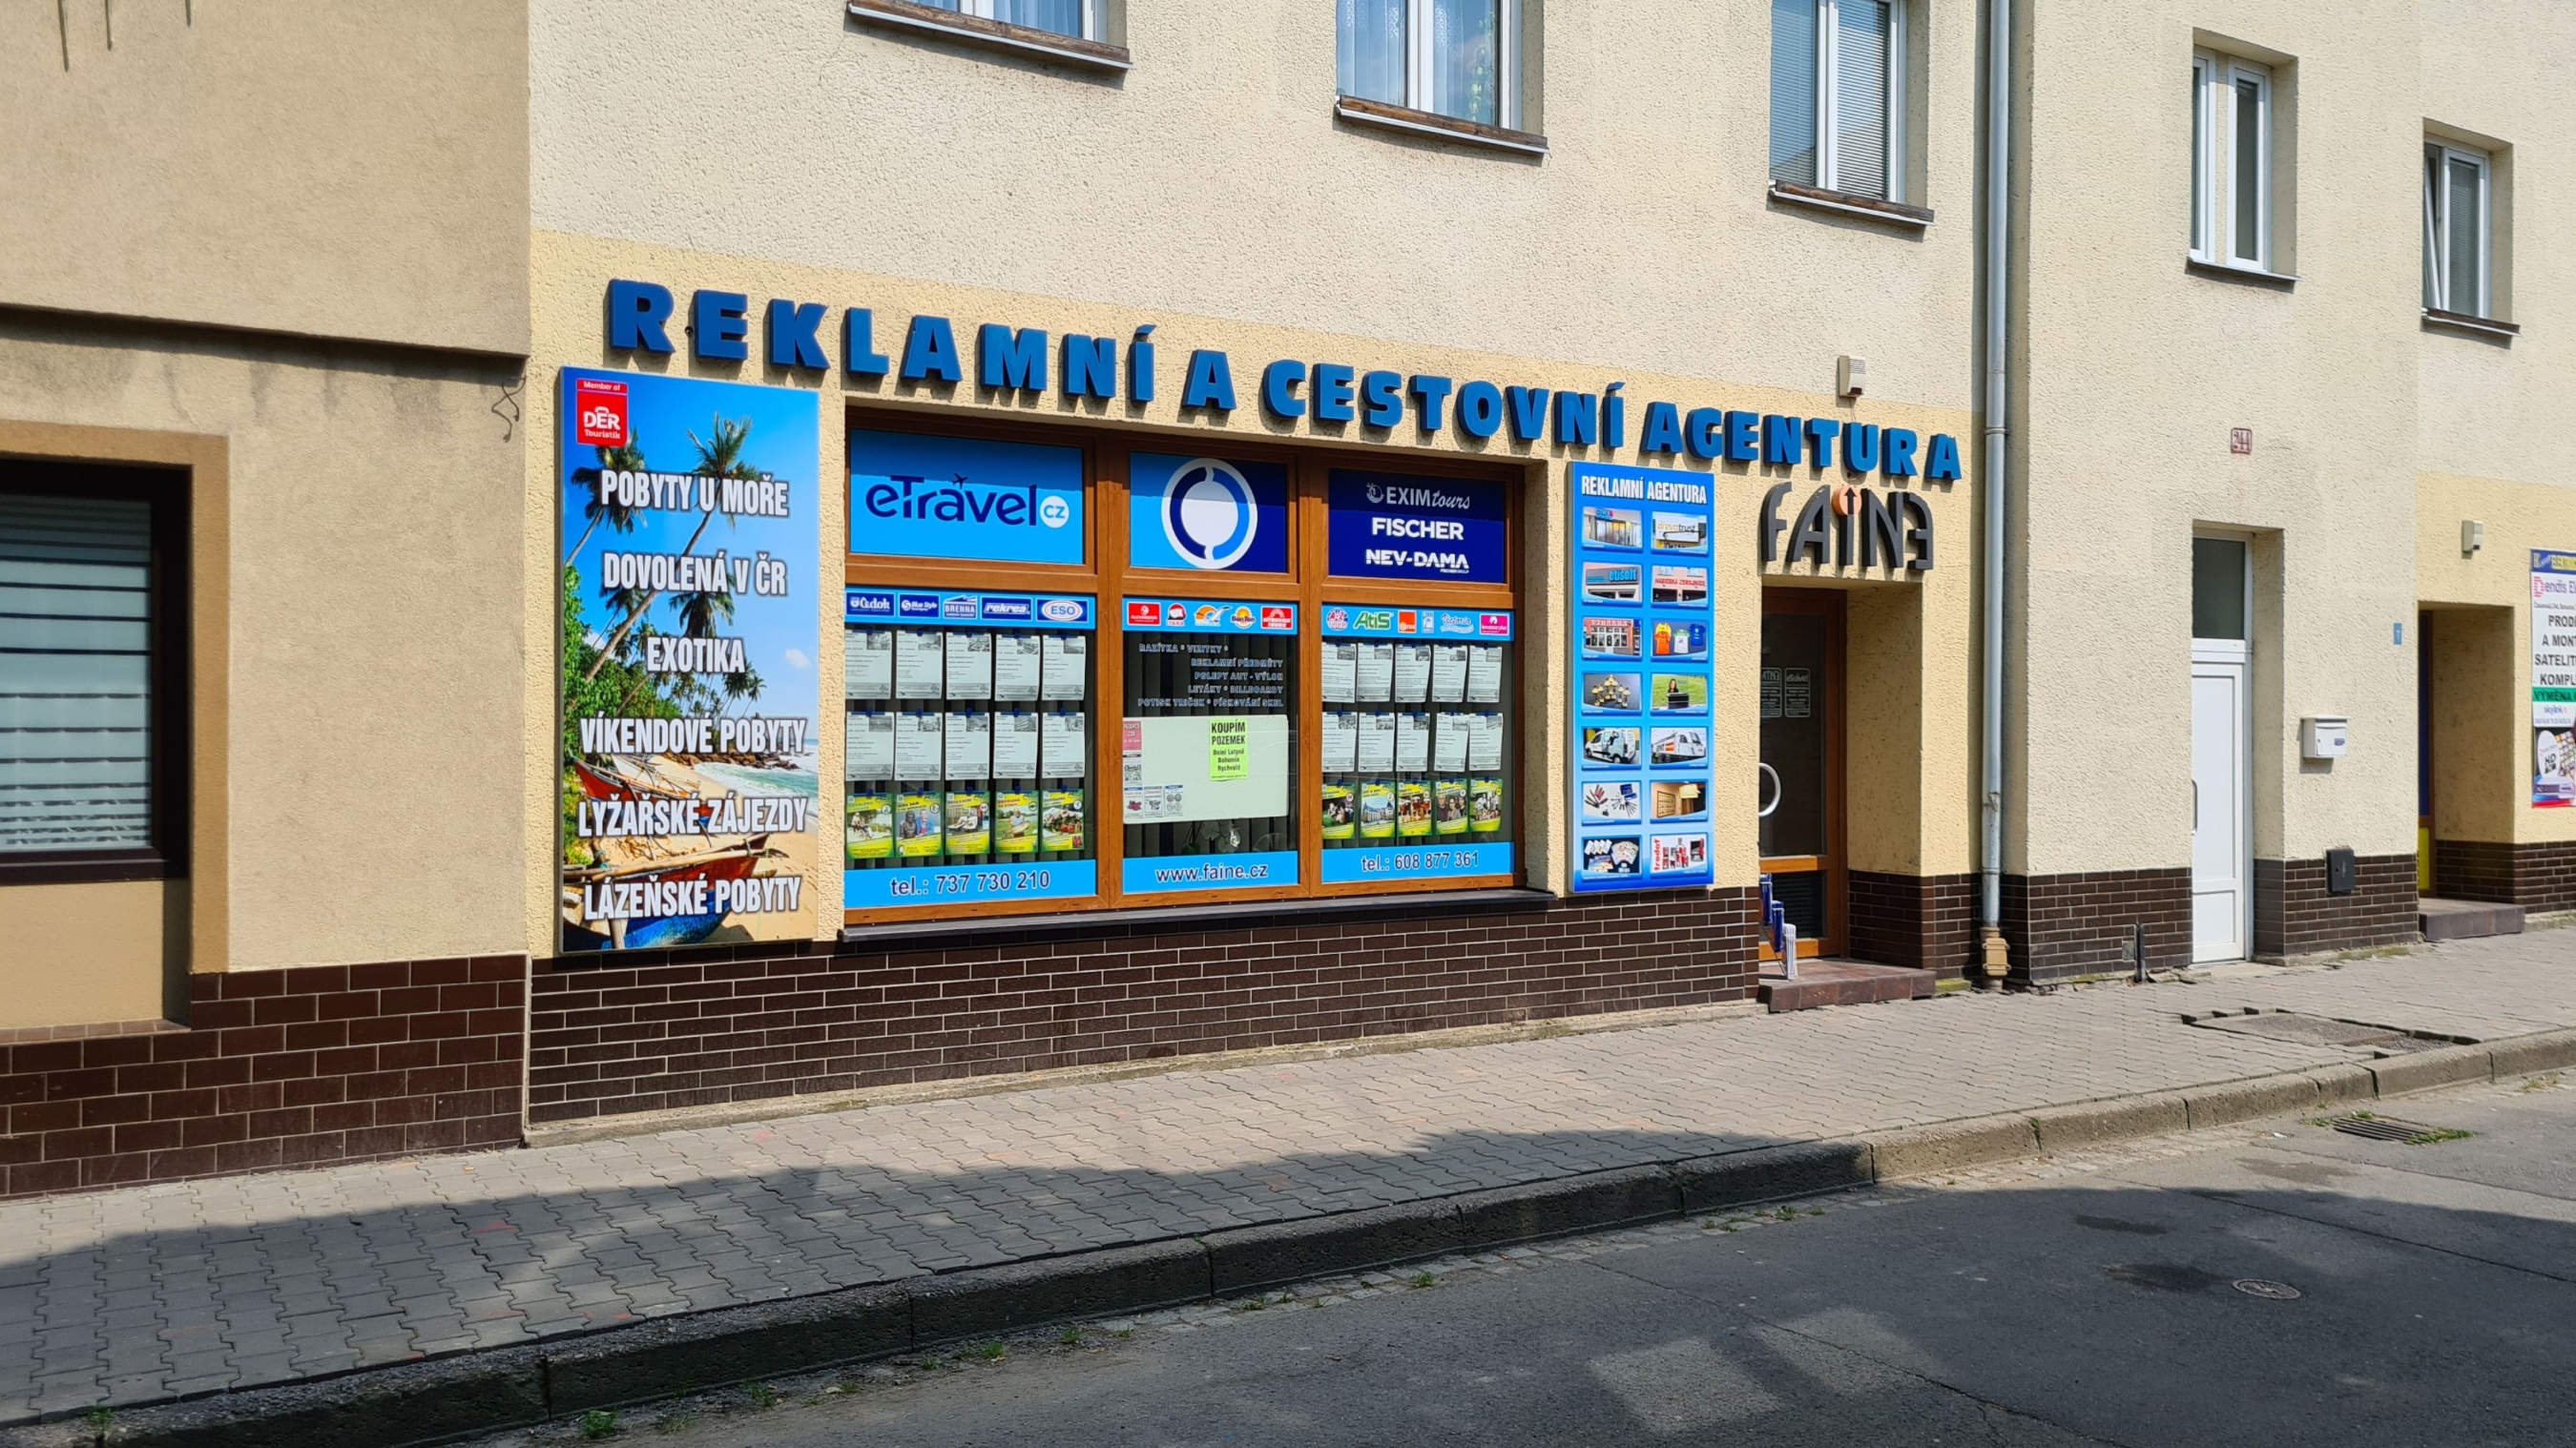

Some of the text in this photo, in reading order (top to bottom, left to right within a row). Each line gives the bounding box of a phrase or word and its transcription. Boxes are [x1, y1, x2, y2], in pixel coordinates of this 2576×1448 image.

[584, 381, 612, 390] Member
[609, 279, 1962, 480] REKLAMNÍ A CESTOVNÍ AGENTURA
[584, 428, 621, 439] Touristik
[600, 468, 789, 517] POBYTY U MOŘE
[1581, 475, 1707, 504] REKLAMNÍ AGENTURA
[866, 475, 1037, 527] eTravel
[1372, 517, 1465, 540] FISCHER
[1365, 548, 1469, 569] NEV-DAMA
[603, 550, 787, 596] DOVOLENÁ V ČR
[945, 604, 975, 613] BRENNA
[1050, 606, 1075, 615] ESO
[2548, 614, 2576, 628] PROD
[2542, 633, 2549, 646] A
[647, 637, 745, 673] EXOTIKA
[1191, 657, 1284, 668] REKLAMNÍ PŘEDMĚTY
[2534, 653, 2576, 666] SATELIT
[2540, 673, 2576, 686] KOMPL
[579, 711, 807, 754] VÍKENDOVÉ POBYTY
[1211, 718, 1246, 733] KOUPÍM
[1211, 735, 1246, 746] POZEMEK
[577, 791, 808, 838] LYŽAŘSKÉ ZÁJEZDY
[1361, 851, 1479, 872] tel.: 608 877 361
[890, 870, 1049, 897] tel.: 737 730 210
[1155, 863, 1268, 883] www.faine.cz
[584, 872, 801, 921] LÁZEŇSKÉ POBYTY
